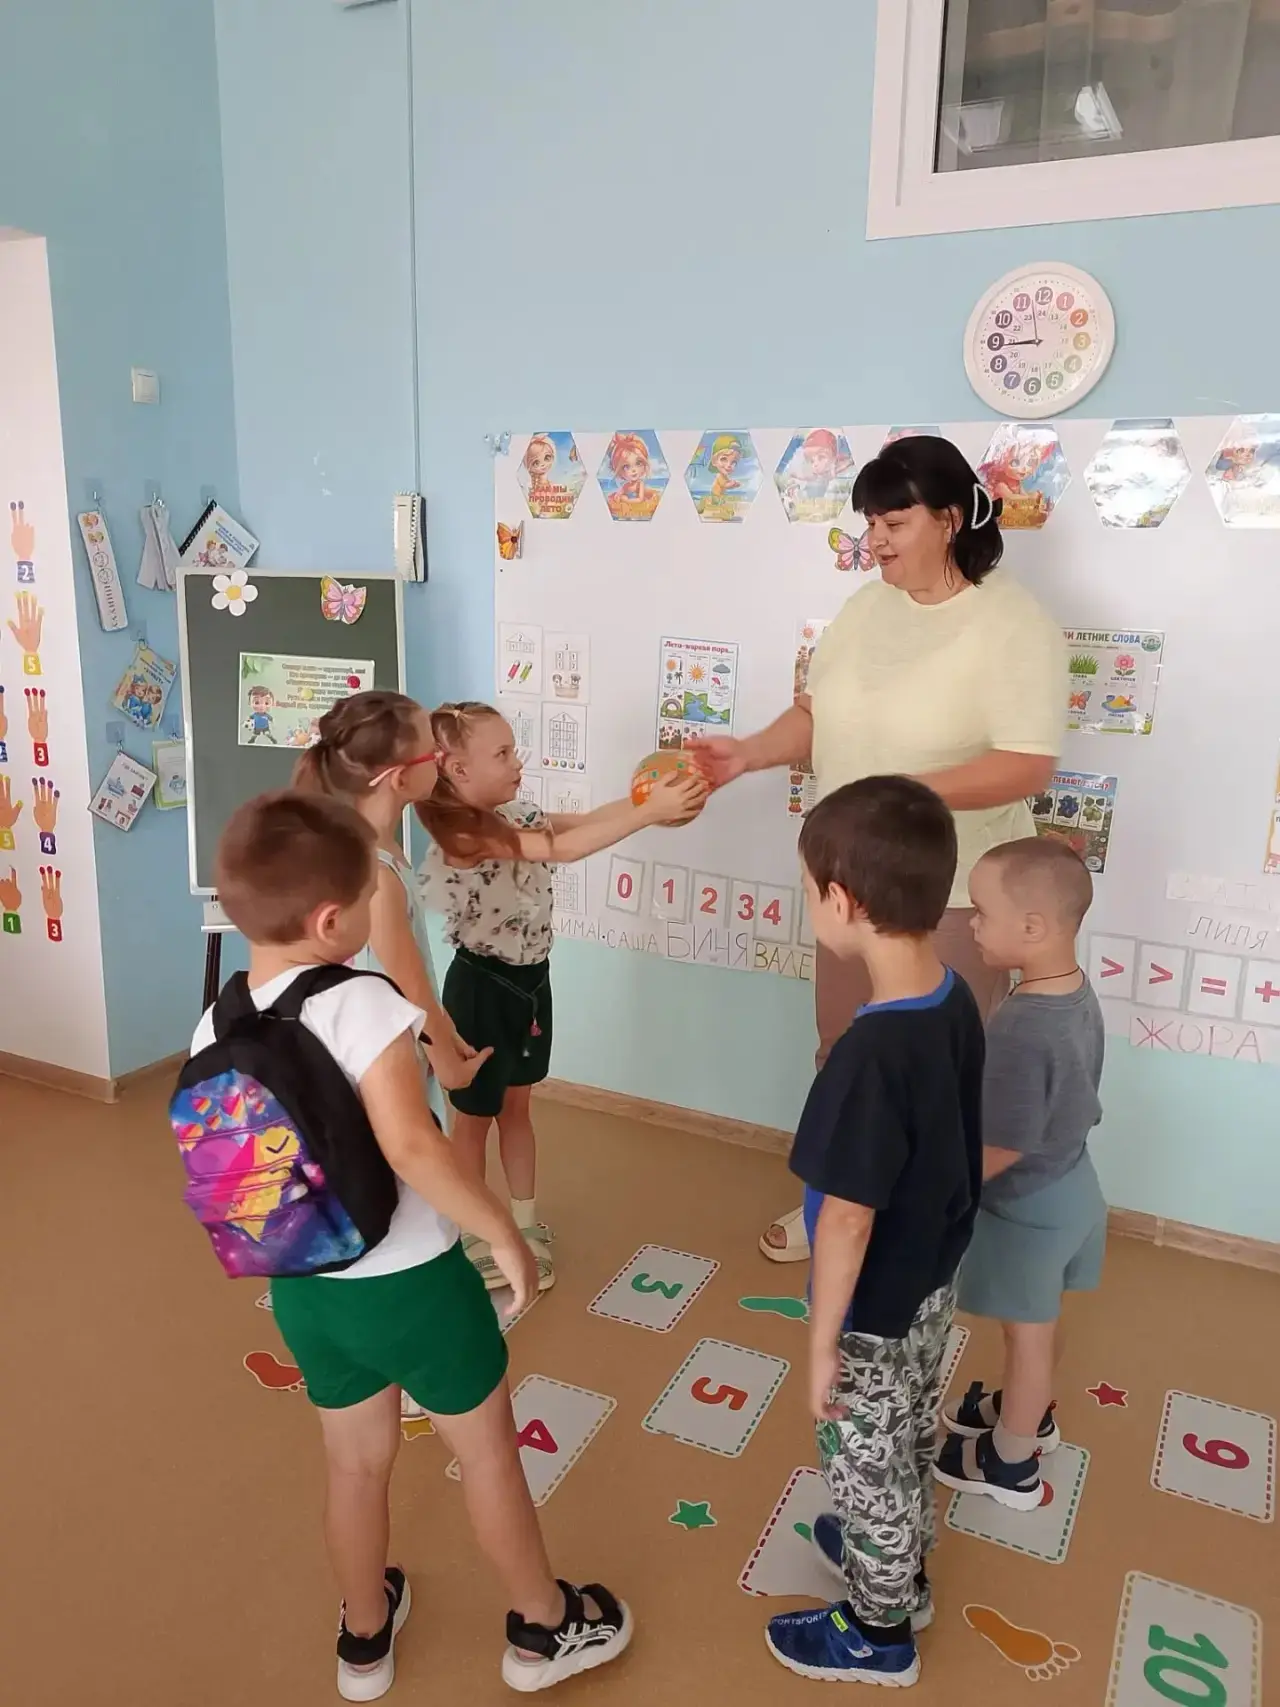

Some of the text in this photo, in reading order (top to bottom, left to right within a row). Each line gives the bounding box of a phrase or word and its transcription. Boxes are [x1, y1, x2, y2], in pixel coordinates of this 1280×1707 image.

[1016, 296, 1028, 309] 11
[1036, 290, 1052, 301] 12
[997, 313, 1011, 326] 10
[1074, 313, 1084, 325] 2
[992, 336, 1001, 349] 9
[1078, 336, 1086, 347] 3
[994, 358, 1003, 370] 8
[1028, 381, 1037, 393] 6
[528, 495, 574, 503] ПРОВОДИМ
[21, 564, 30, 580] 2
[1076, 632, 1110, 642] ЛЕТНИЕ
[1112, 634, 1141, 644] СЛОВА
[27, 656, 36, 672] 5
[37, 747, 45, 761] 3
[44, 837, 52, 851] 4
[617, 873, 781, 925] 0 1 2 3 4
[51, 923, 60, 937] 3
[552, 917, 597, 941] ИМА
[606, 929, 659, 953] САША
[754, 942, 814, 981] ВАЛЕ
[1137, 1017, 1262, 1064] ЖОРА
[631, 1272, 683, 1300] 3
[691, 1376, 748, 1411] 5
[1143, 1624, 1229, 1707] 10
